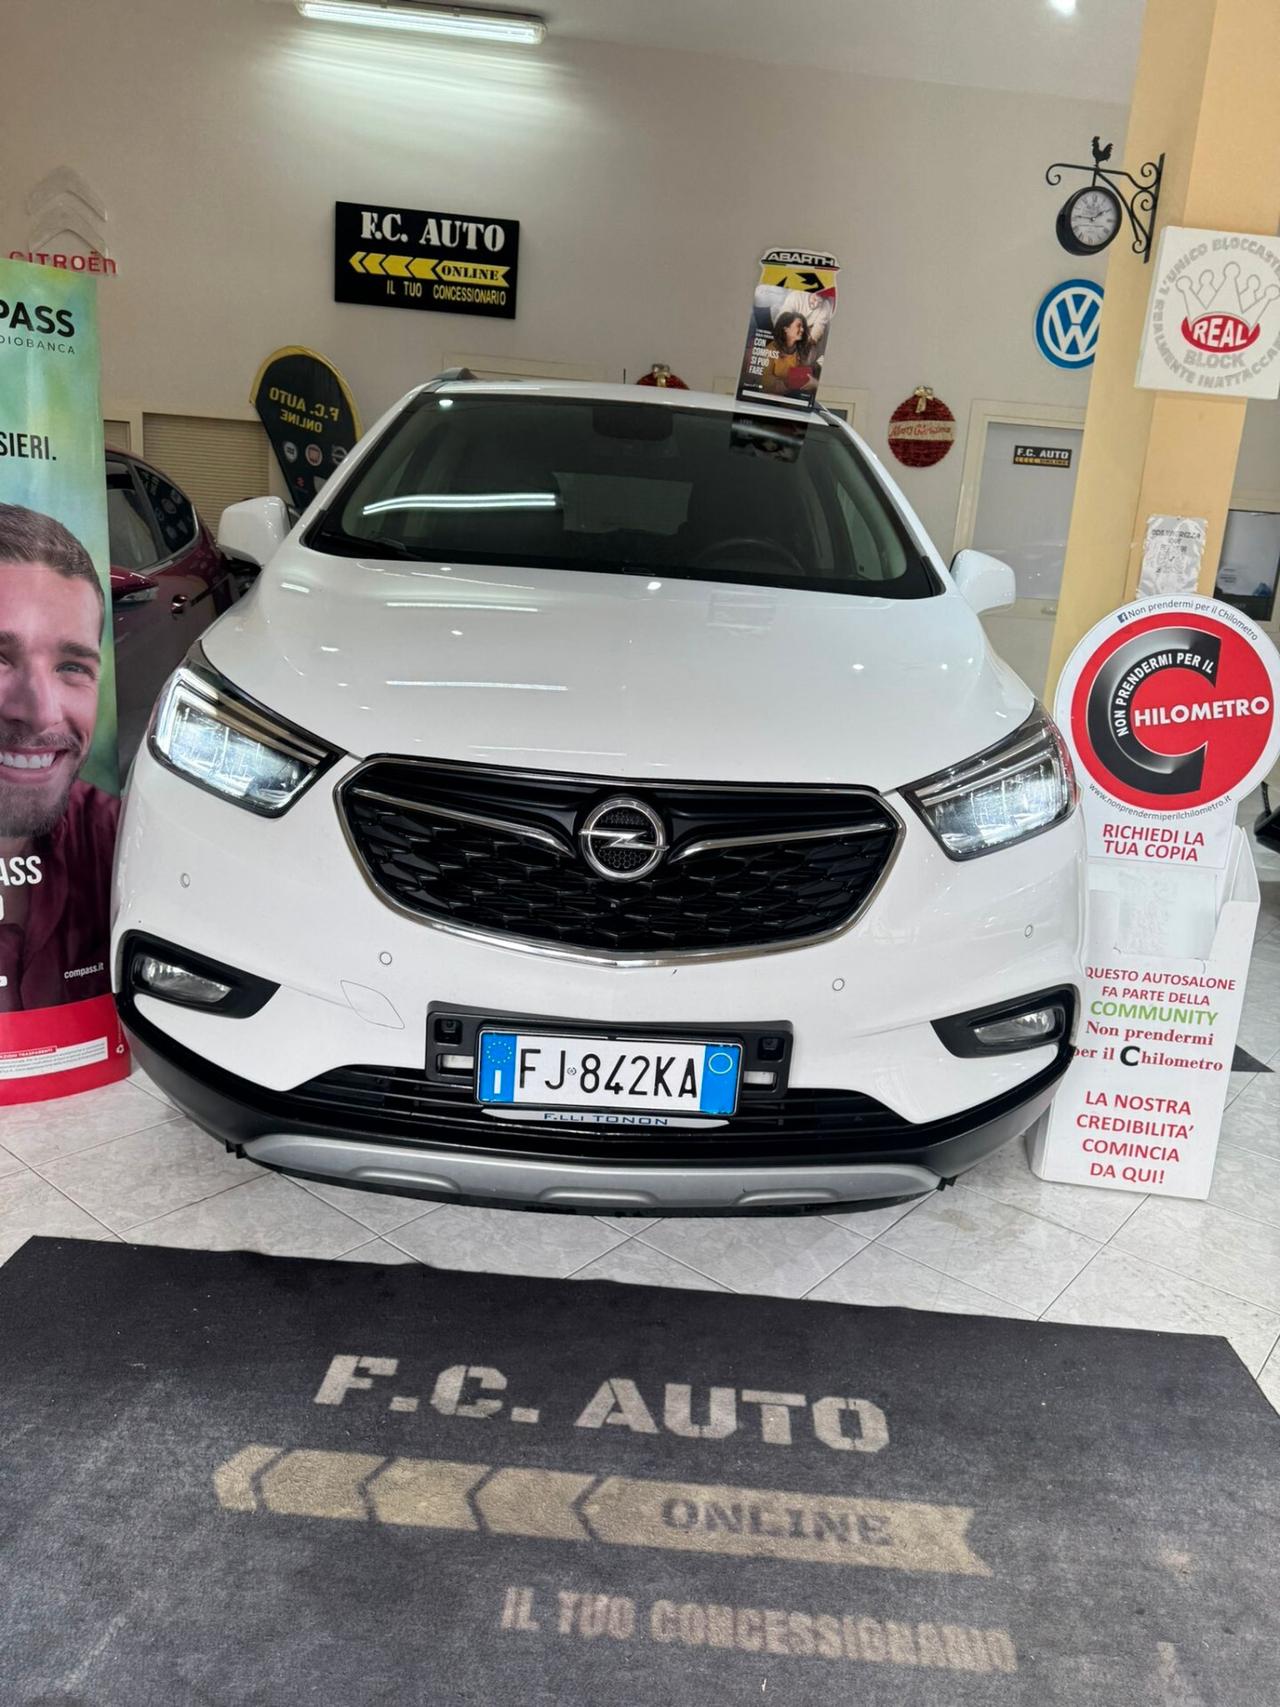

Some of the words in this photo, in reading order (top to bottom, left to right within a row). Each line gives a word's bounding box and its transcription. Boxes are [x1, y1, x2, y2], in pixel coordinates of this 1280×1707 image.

[361, 211, 408, 242] F.C.
[419, 218, 506, 252] AUTO
[768, 252, 834, 266] ABARTH
[441, 264, 500, 281] ONLINE
[386, 280, 396, 295] IL
[403, 281, 423, 297] TUO
[433, 284, 507, 306] CONCESSIONARIO
[1153, 299, 1197, 384] REALMENTE
[1192, 318, 1248, 348] REAL
[1183, 350, 1246, 369] BLOCK
[1040, 449, 1069, 459] AUTO
[1128, 605, 1147, 619] Non
[1148, 600, 1194, 613] prendermi
[1194, 602, 1210, 613] per
[1211, 604, 1218, 613] il
[1218, 608, 1258, 641] Chilometro
[1176, 652, 1202, 668] PER
[1202, 659, 1213, 674] IL
[1117, 653, 1173, 706] PRENDERMI
[1114, 709, 1130, 738] NON
[1089, 783, 1232, 822] www.nonprendermiperilchilometro.it
[1103, 823, 1179, 844] RICHIEDI
[1184, 831, 1205, 846] LA
[1104, 839, 1139, 857] TUA
[1144, 843, 1199, 862] COPIA
[64, 962, 104, 980] compass.it
[1085, 966, 1139, 982] QUESTO
[1141, 971, 1237, 991] AUTOSALONE
[1102, 986, 1118, 998] FA
[1122, 988, 1165, 1002] PARTE
[1168, 992, 1211, 1006] DELLA
[1090, 1000, 1218, 1026] COMMUNITY
[1086, 1020, 1119, 1037] Non
[1124, 1028, 1214, 1046] prendermi
[1102, 1047, 1115, 1060] il
[1119, 1045, 1224, 1072] Chilometro
[1085, 1090, 1108, 1107] LA
[1114, 1093, 1192, 1116] NOSTRA
[543, 1112, 586, 1122] F.LLI
[592, 1114, 669, 1126] TONON
[1081, 1138, 1180, 1163] COMINCIA
[1090, 1162, 1116, 1179] DA
[1122, 1166, 1165, 1185] QUI!
[312, 1353, 540, 1424] F.C.
[573, 1377, 893, 1454] AUTO
[660, 1493, 894, 1547] ONLINE
[500, 1586, 541, 1632] IL
[556, 1590, 634, 1640] TUO
[649, 1598, 1019, 1675] CONCESSIONARIO
